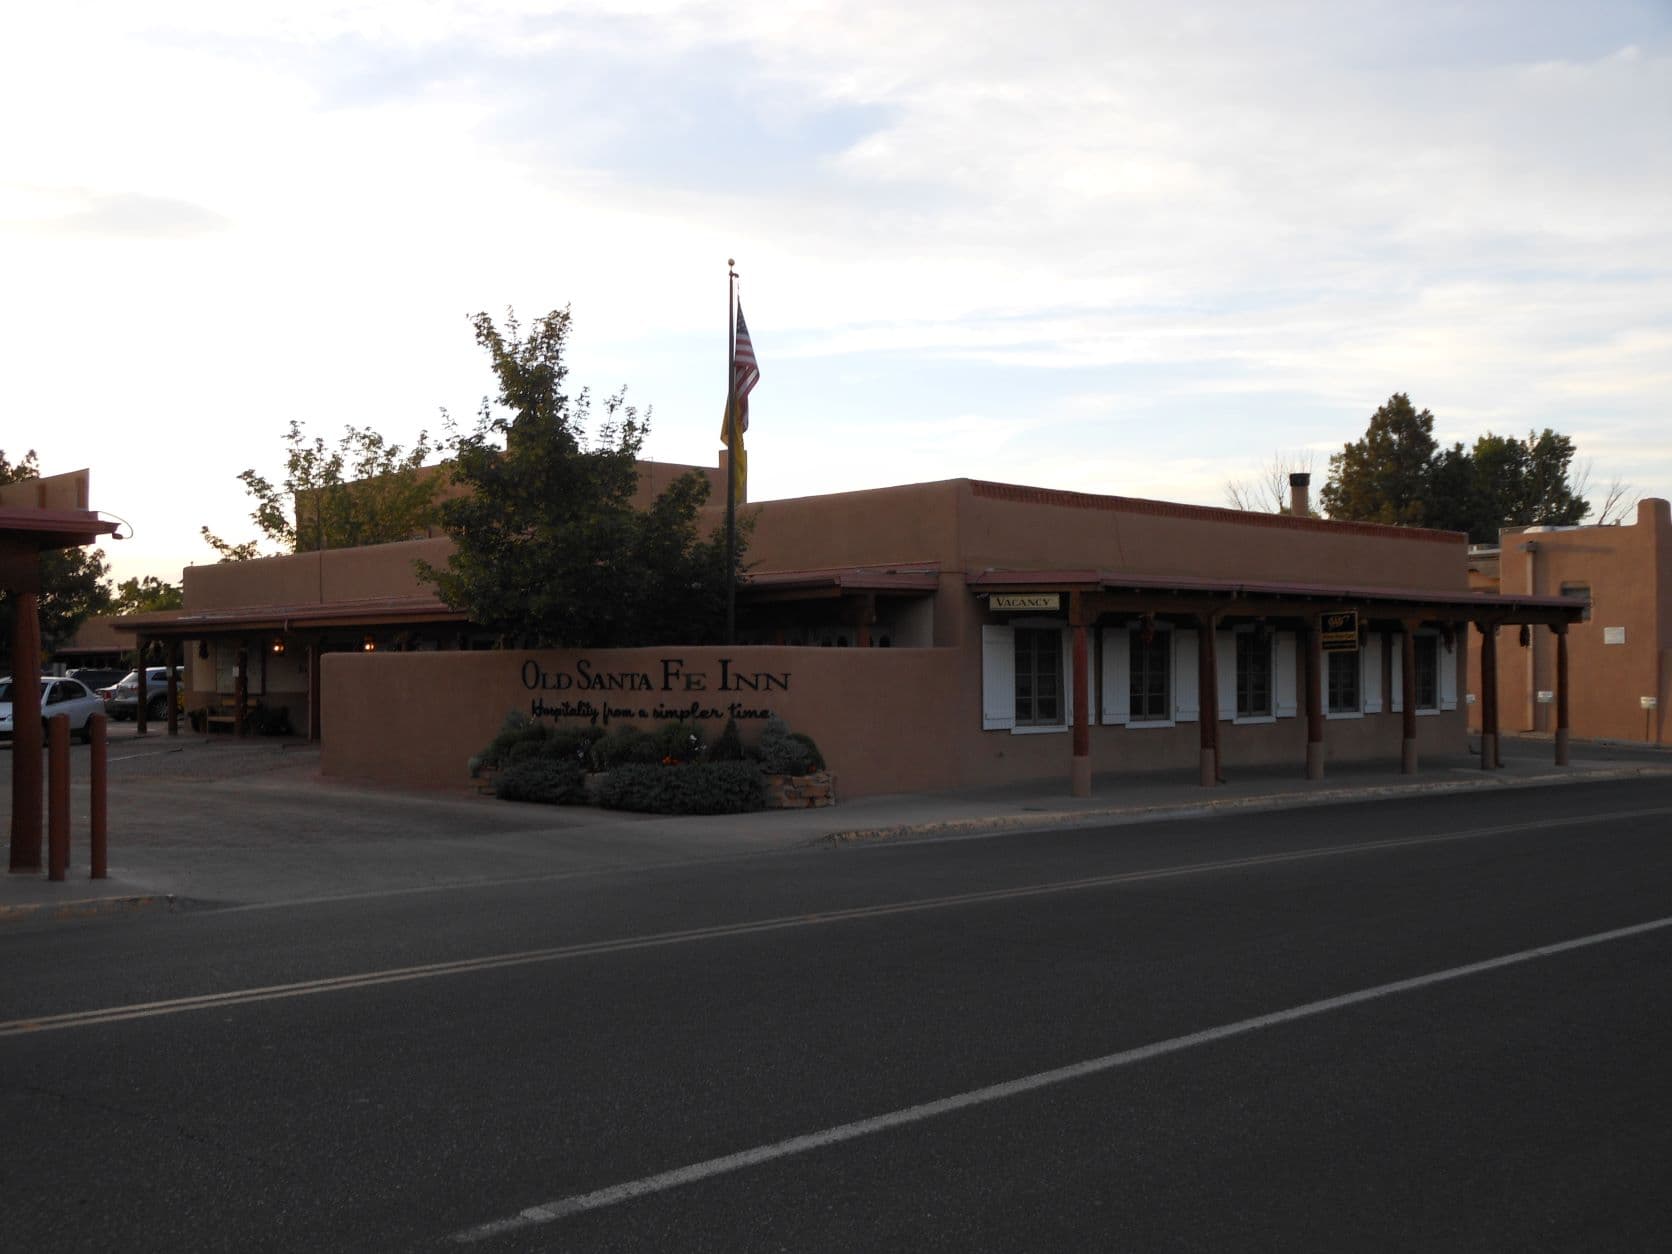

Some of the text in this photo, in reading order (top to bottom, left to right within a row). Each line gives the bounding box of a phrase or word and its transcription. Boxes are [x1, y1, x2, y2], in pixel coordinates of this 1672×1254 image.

[997, 598, 1050, 607] VACANCY
[522, 659, 792, 690] OLD SANTA FE INN
[532, 698, 599, 724] Hospitality
[603, 701, 635, 725] from
[638, 708, 649, 718] a
[653, 701, 723, 722] simpler
